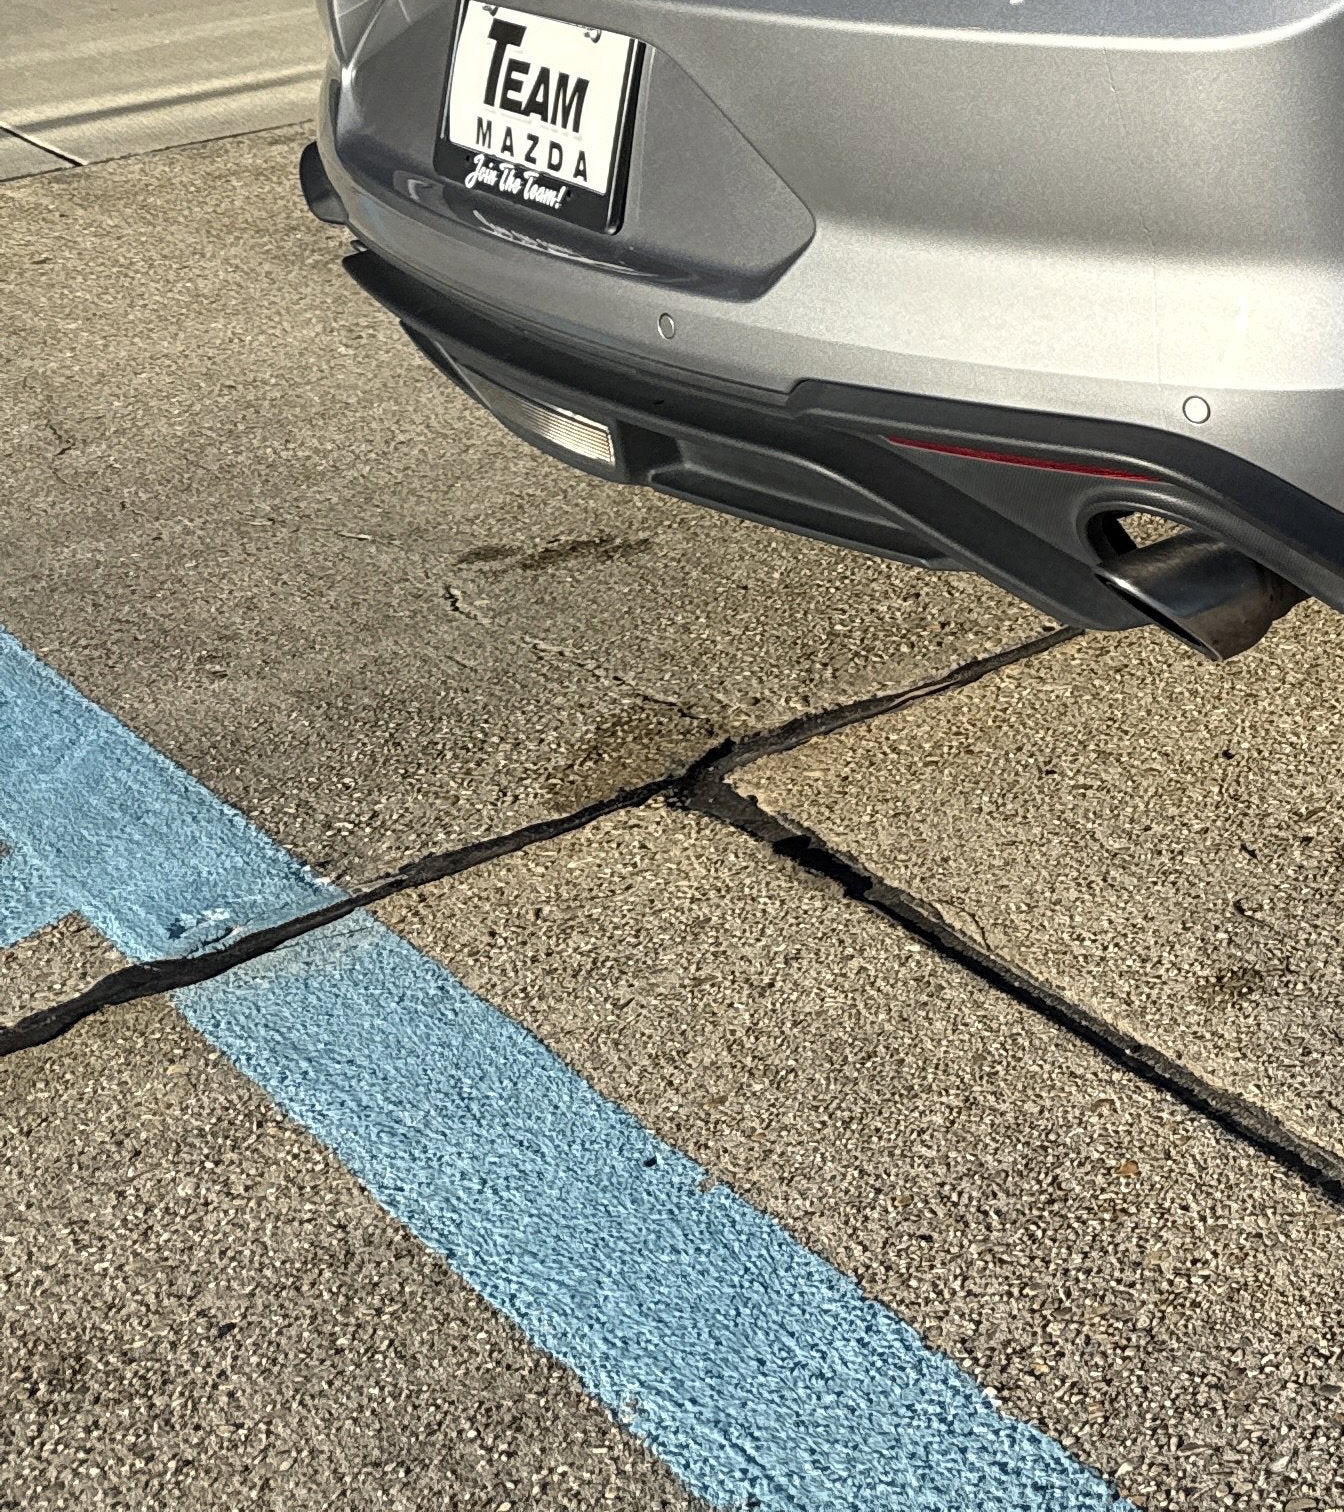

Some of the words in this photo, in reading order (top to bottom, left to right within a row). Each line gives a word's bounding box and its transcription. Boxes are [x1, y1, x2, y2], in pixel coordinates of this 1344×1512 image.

[483, 17, 590, 133] TEAM
[465, 153, 498, 189] Join
[498, 162, 522, 194] The
[523, 171, 567, 209] Team!
[476, 116, 588, 182] MAZDA
